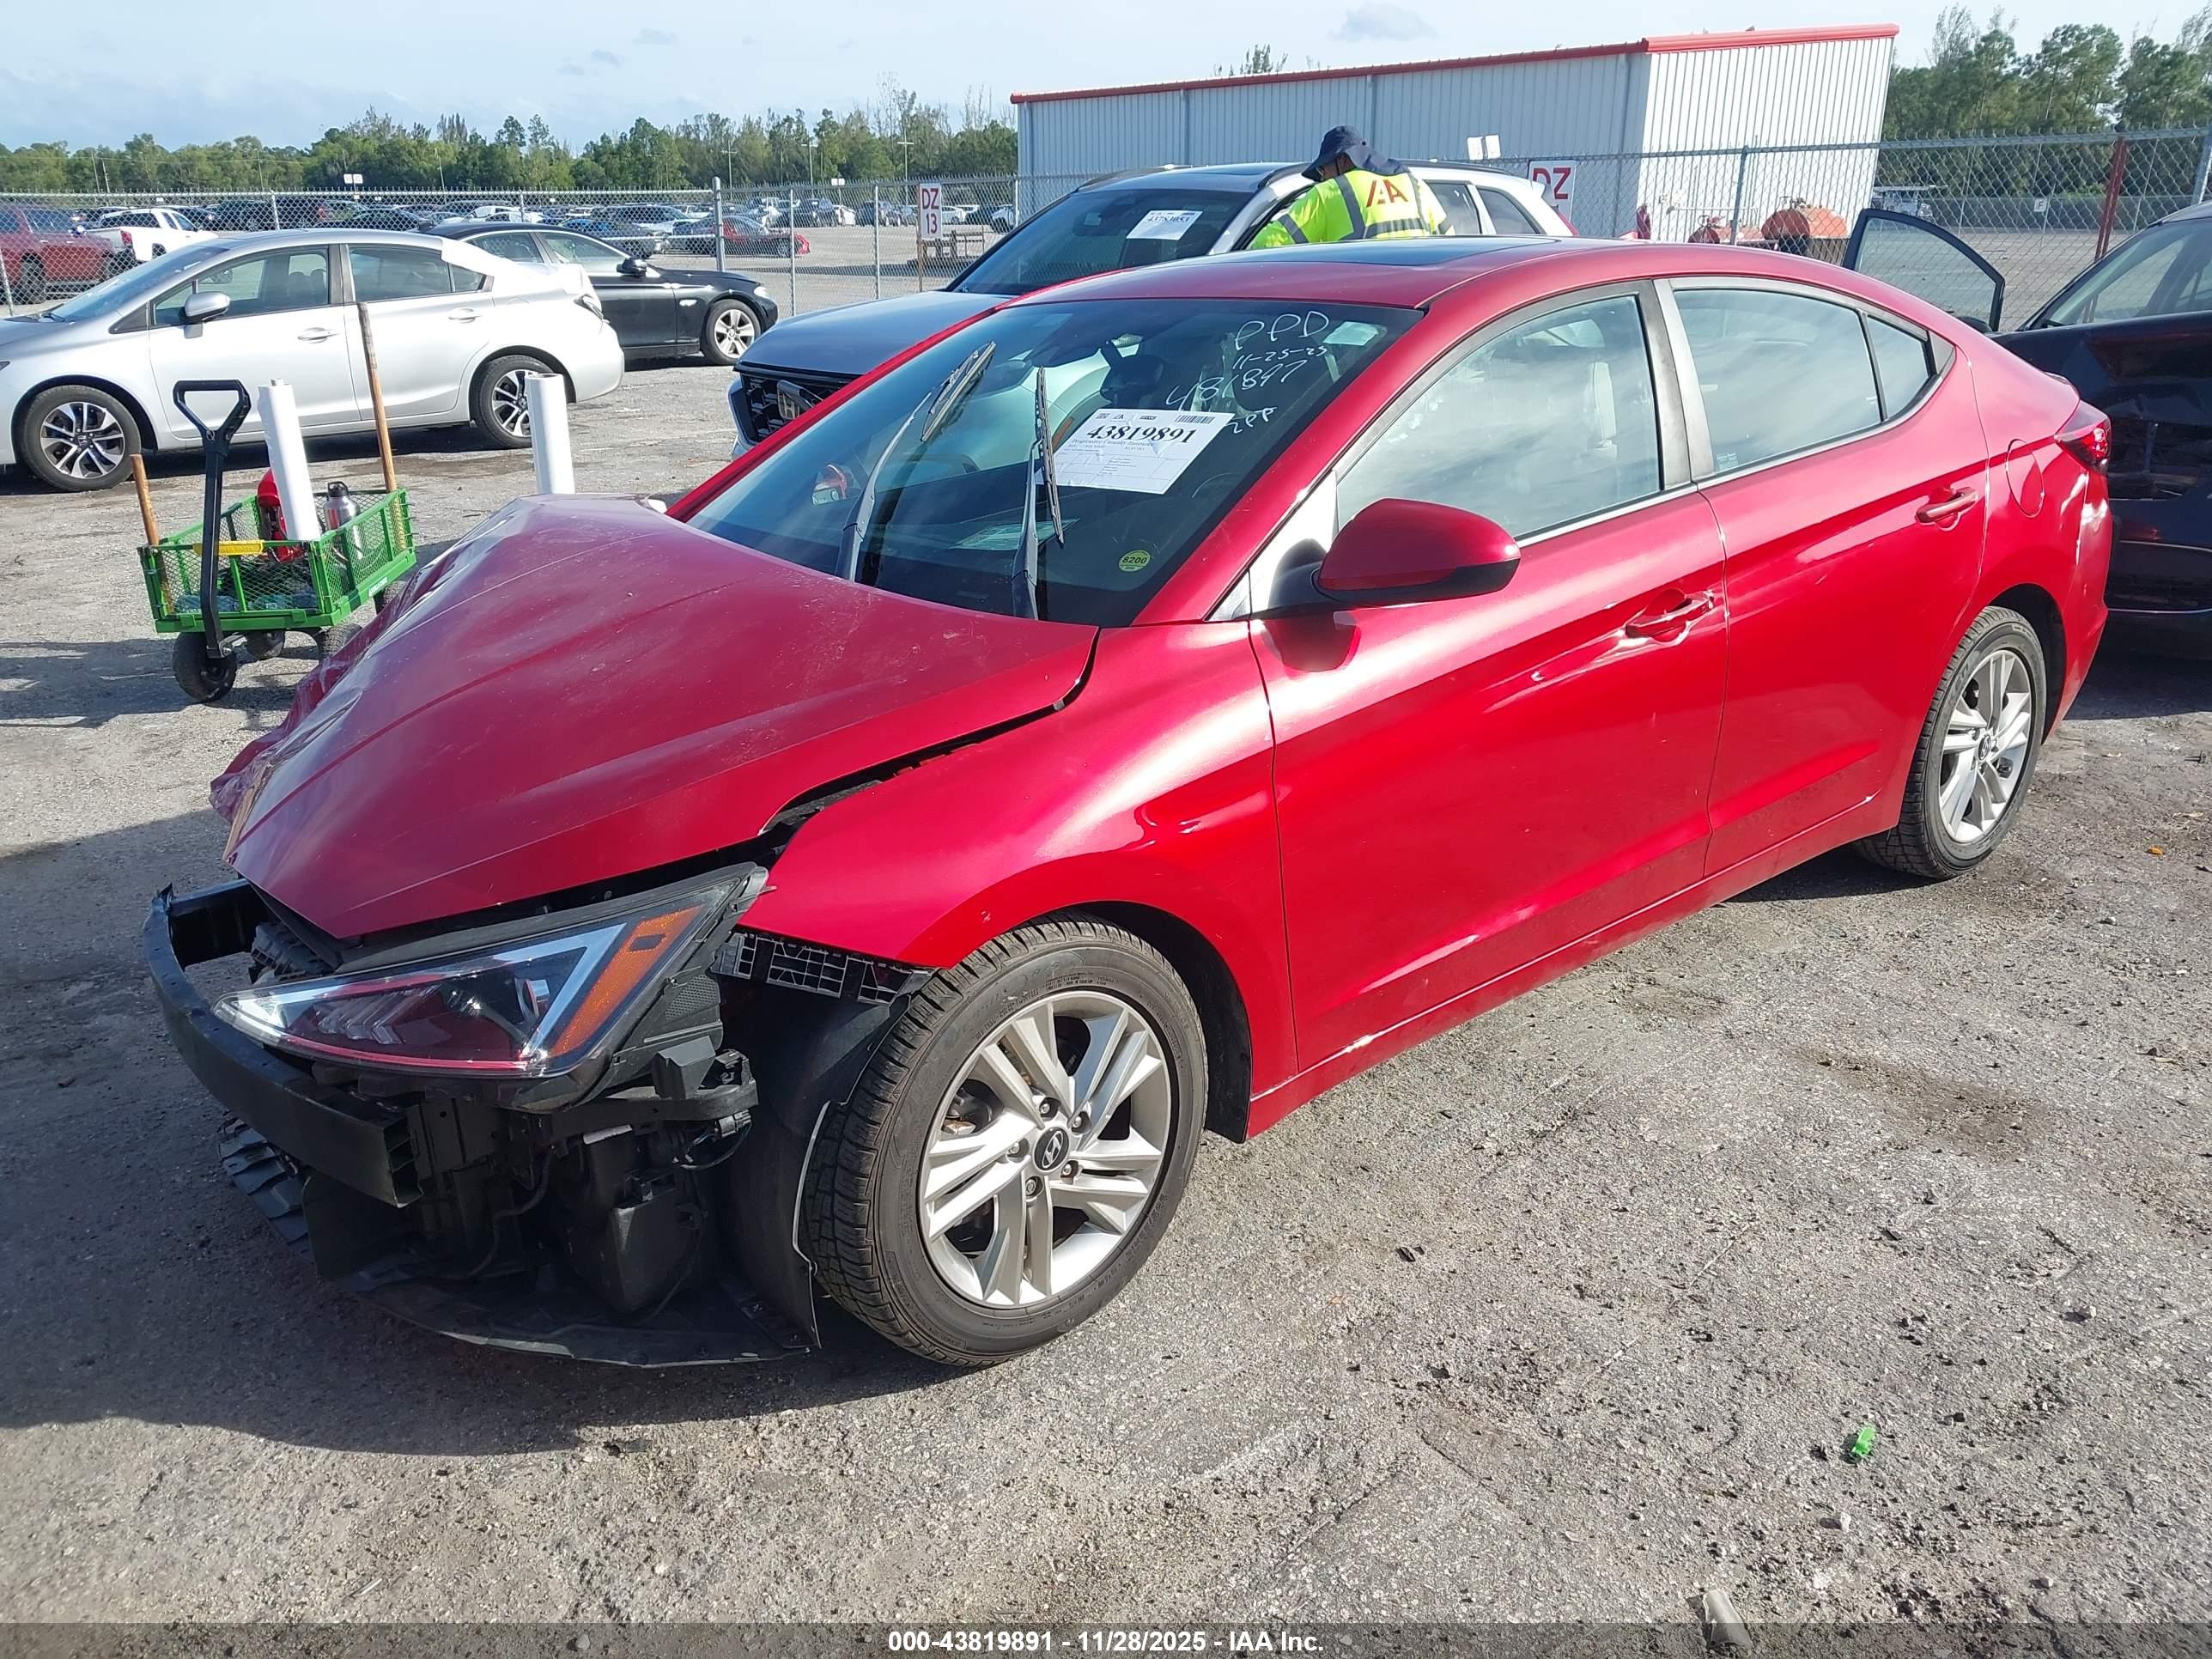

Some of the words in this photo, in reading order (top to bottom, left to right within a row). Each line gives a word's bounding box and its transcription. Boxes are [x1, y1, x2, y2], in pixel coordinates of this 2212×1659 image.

[921, 188, 939, 210] DZ
[926, 213, 938, 234] 13
[1086, 425, 1197, 444] 43819891
